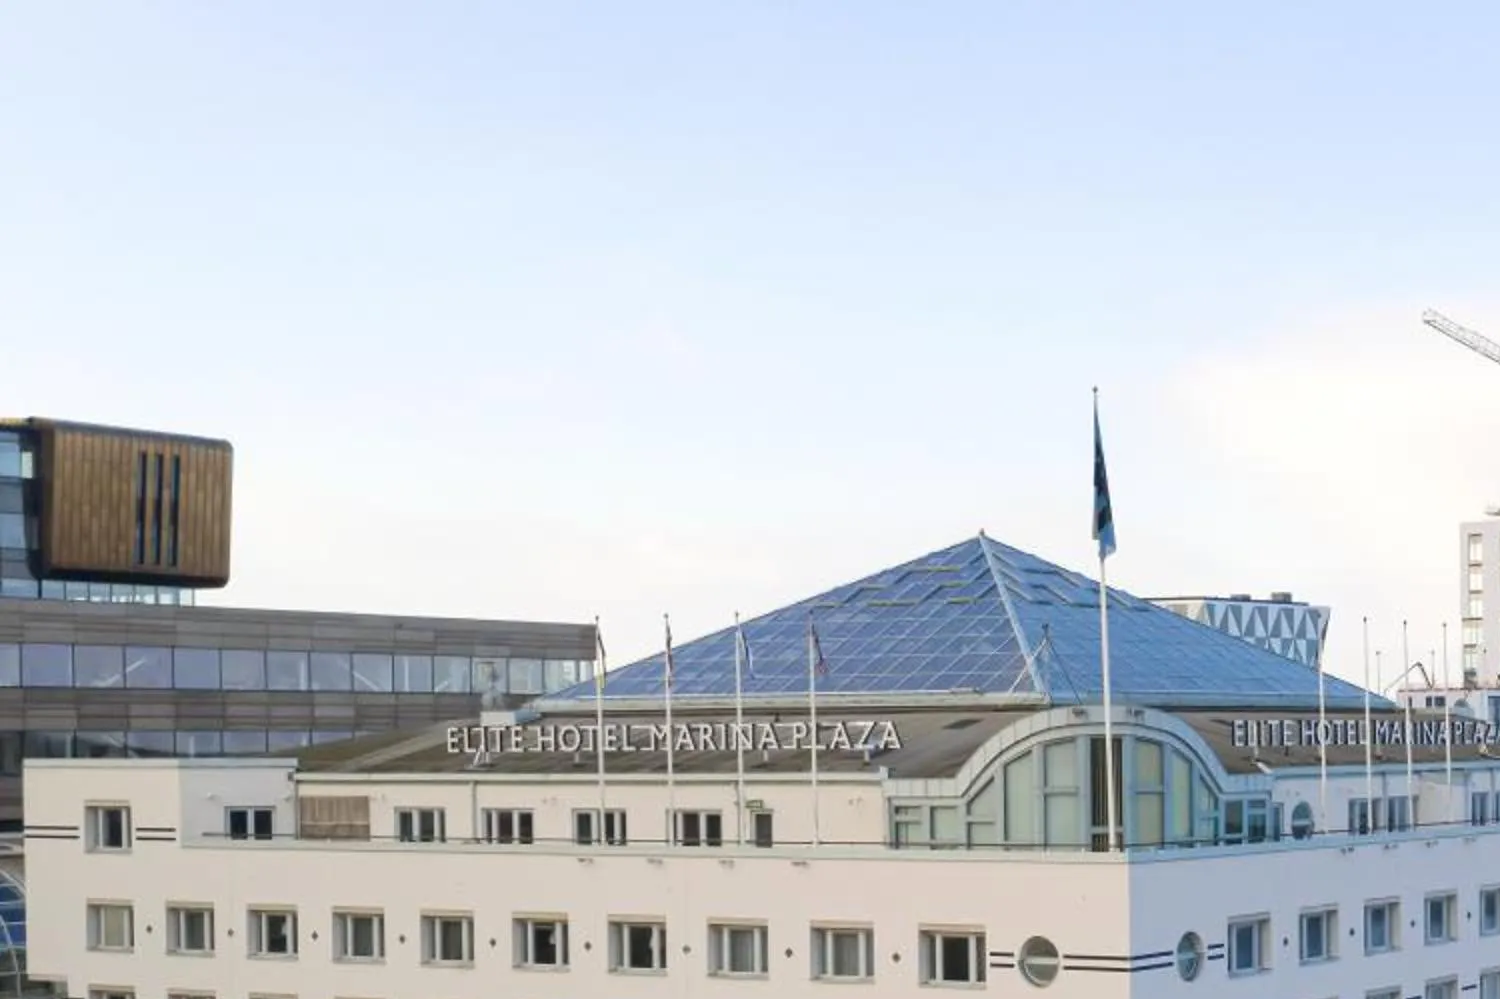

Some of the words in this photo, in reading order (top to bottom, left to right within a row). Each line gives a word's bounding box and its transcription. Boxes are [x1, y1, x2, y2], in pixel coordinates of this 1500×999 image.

[446, 726, 524, 753] ELITE
[535, 724, 636, 752] HOTEL
[650, 722, 780, 751] MARINA
[792, 720, 902, 750] PAZA
[1233, 719, 1295, 746] ELITE
[1301, 719, 1369, 745] HOTEL
